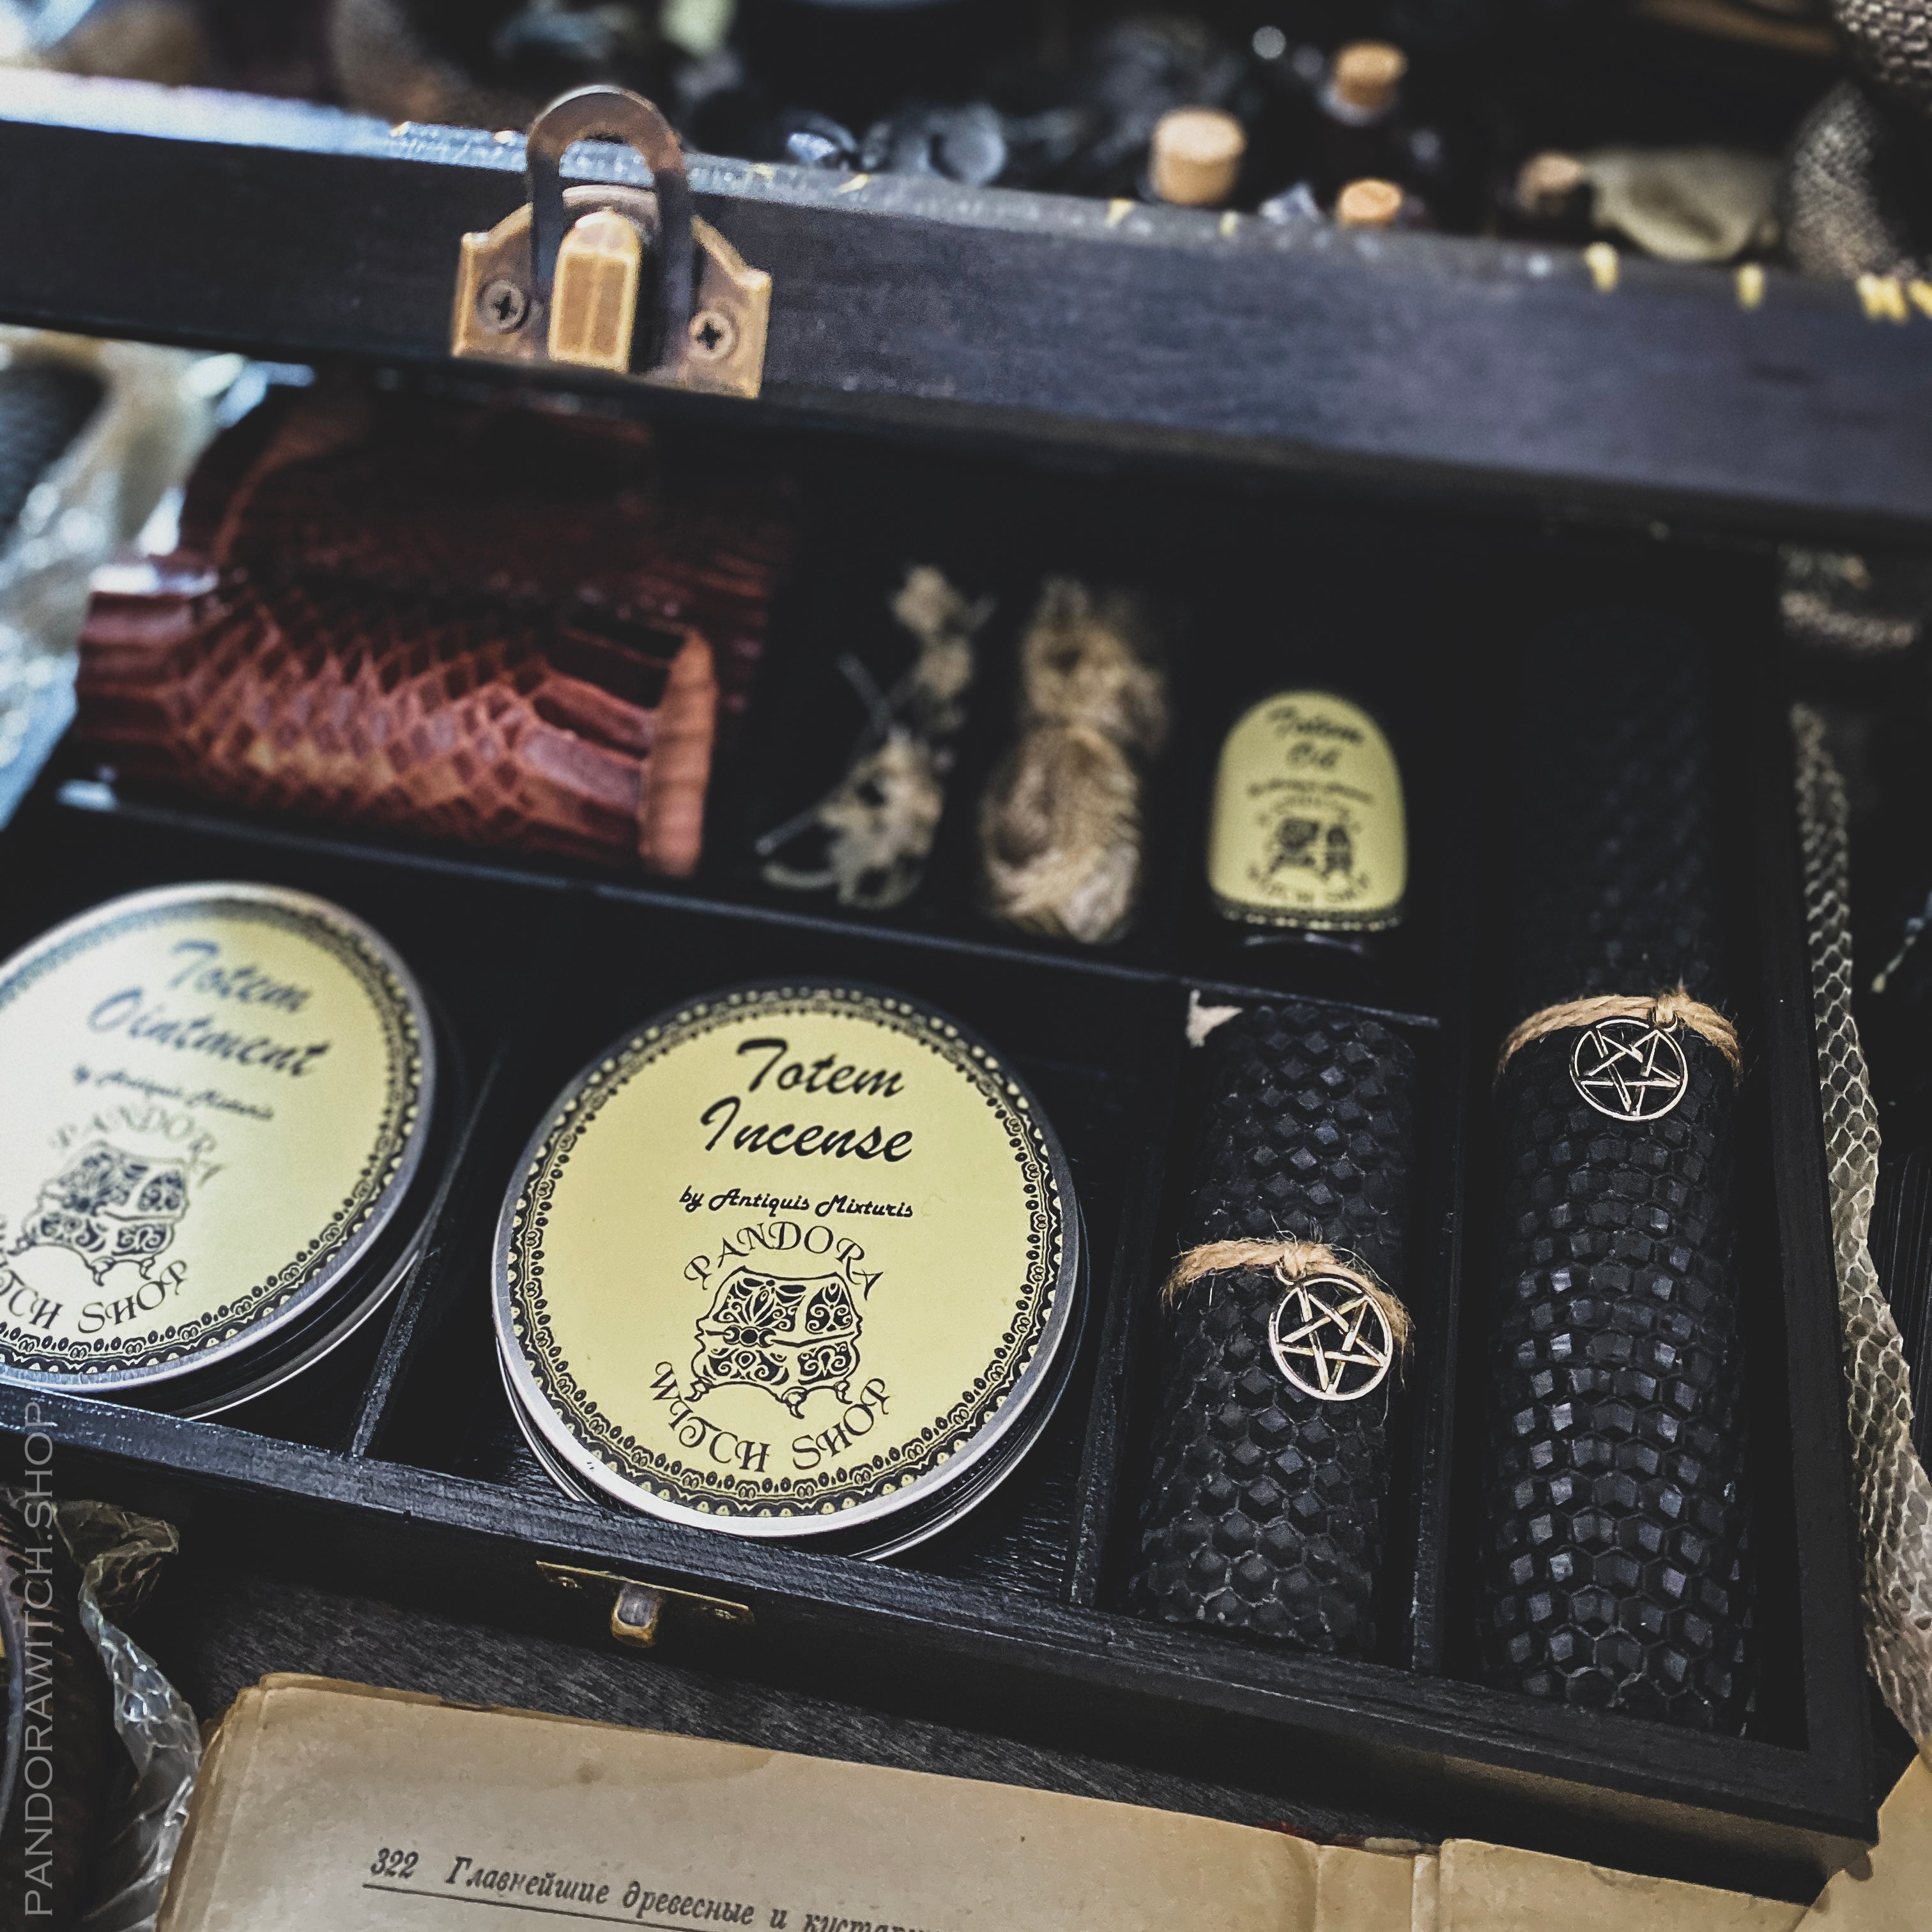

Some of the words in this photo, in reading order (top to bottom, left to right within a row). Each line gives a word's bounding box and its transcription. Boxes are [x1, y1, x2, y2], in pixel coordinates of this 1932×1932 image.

[169, 940, 312, 1013] Totem
[88, 986, 330, 1076] Ointment
[737, 1038, 905, 1098] Totem
[700, 1096, 914, 1163] Incense
[678, 1184, 705, 1213] by
[708, 1188, 810, 1218] Antiquis
[815, 1194, 914, 1218] Mixturis
[77, 1259, 188, 1334] SHOP
[683, 1221, 884, 1301] PANDORA
[649, 1361, 772, 1473] WITCH
[792, 1377, 891, 1470] SHOP
[370, 1847, 420, 1880] 322
[445, 1855, 610, 1905] Главнейшие
[622, 1880, 755, 1925] древесные
[770, 1908, 787, 1929] и
